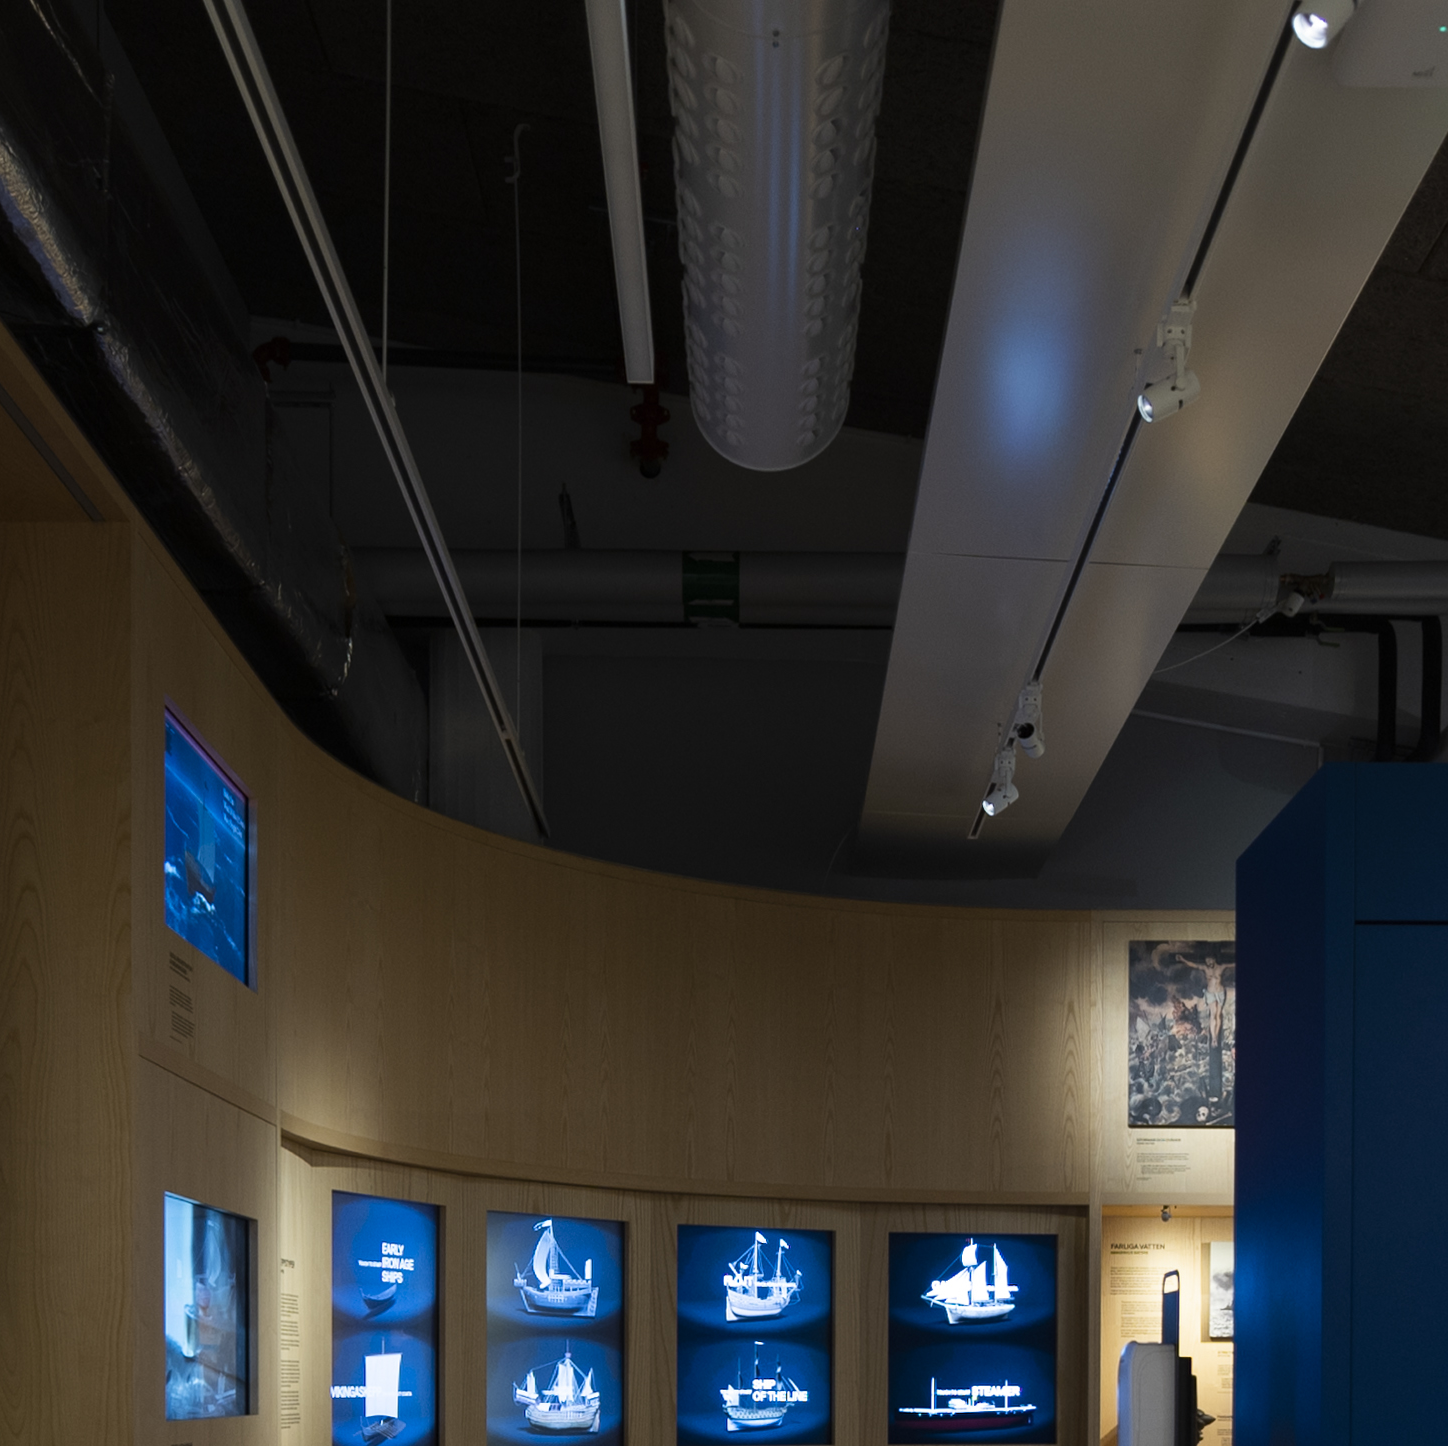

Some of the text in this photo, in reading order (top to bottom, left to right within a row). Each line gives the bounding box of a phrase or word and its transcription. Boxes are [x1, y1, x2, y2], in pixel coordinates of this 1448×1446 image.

[381, 1242, 404, 1256] EARLY
[381, 1256, 400, 1269] IRON
[400, 1258, 414, 1271] AGE
[381, 1270, 403, 1283] SHIPS
[752, 1379, 776, 1390] SHIP
[752, 1391, 767, 1402] OF
[767, 1391, 786, 1402] THE
[786, 1391, 808, 1402] LINE
[971, 1385, 1021, 1397] STEAMER
